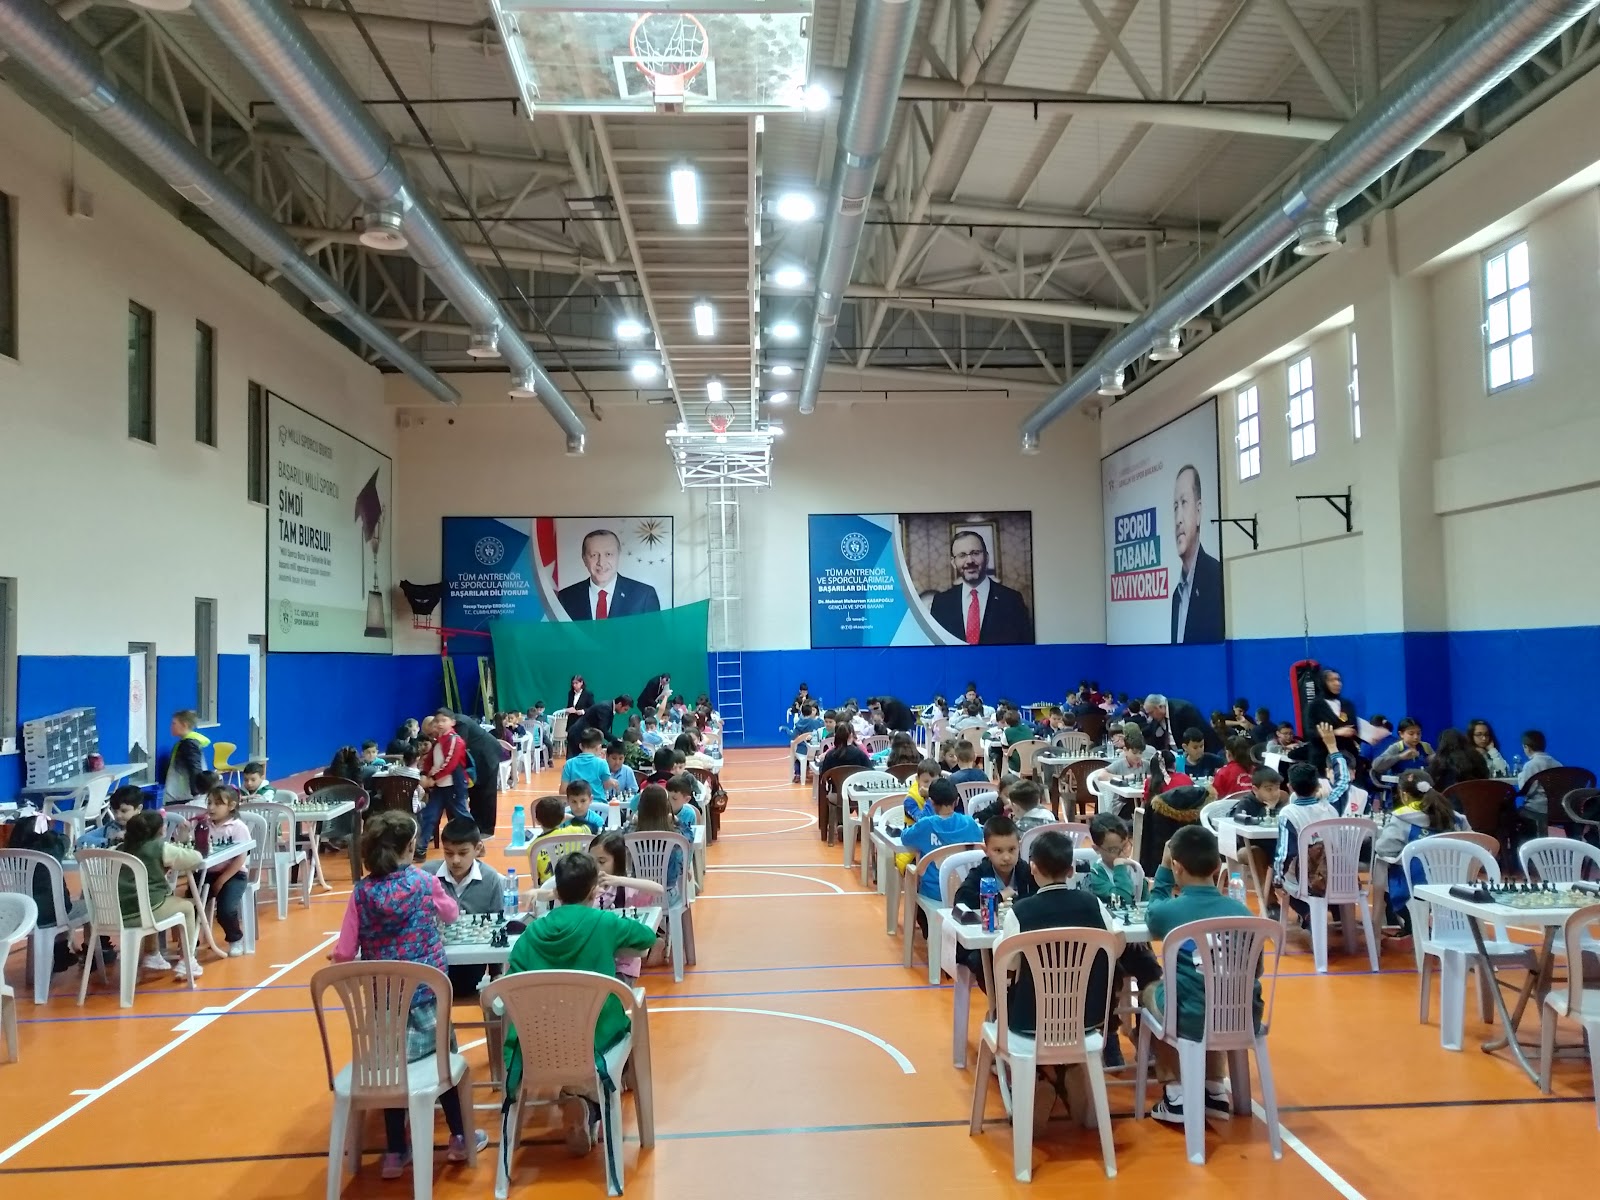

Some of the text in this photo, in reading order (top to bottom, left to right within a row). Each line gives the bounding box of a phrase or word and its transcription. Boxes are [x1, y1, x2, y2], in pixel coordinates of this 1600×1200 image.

[278, 486, 303, 517] ŞİMDİ
[279, 518, 331, 552] TAM BURSLU!
[1118, 512, 1152, 542] SPORU
[1116, 540, 1157, 572] TABANA
[458, 572, 520, 581] TÜM ANTRENÖR
[825, 568, 886, 576] TÜM ANTRENÖR
[828, 576, 894, 584] SPORCULARIMIZA
[460, 580, 530, 589] SPORCULARIMIZA
[818, 584, 894, 593] BAŞARILAR DİLİYORUM
[1112, 570, 1168, 600] YAYIYORUZ
